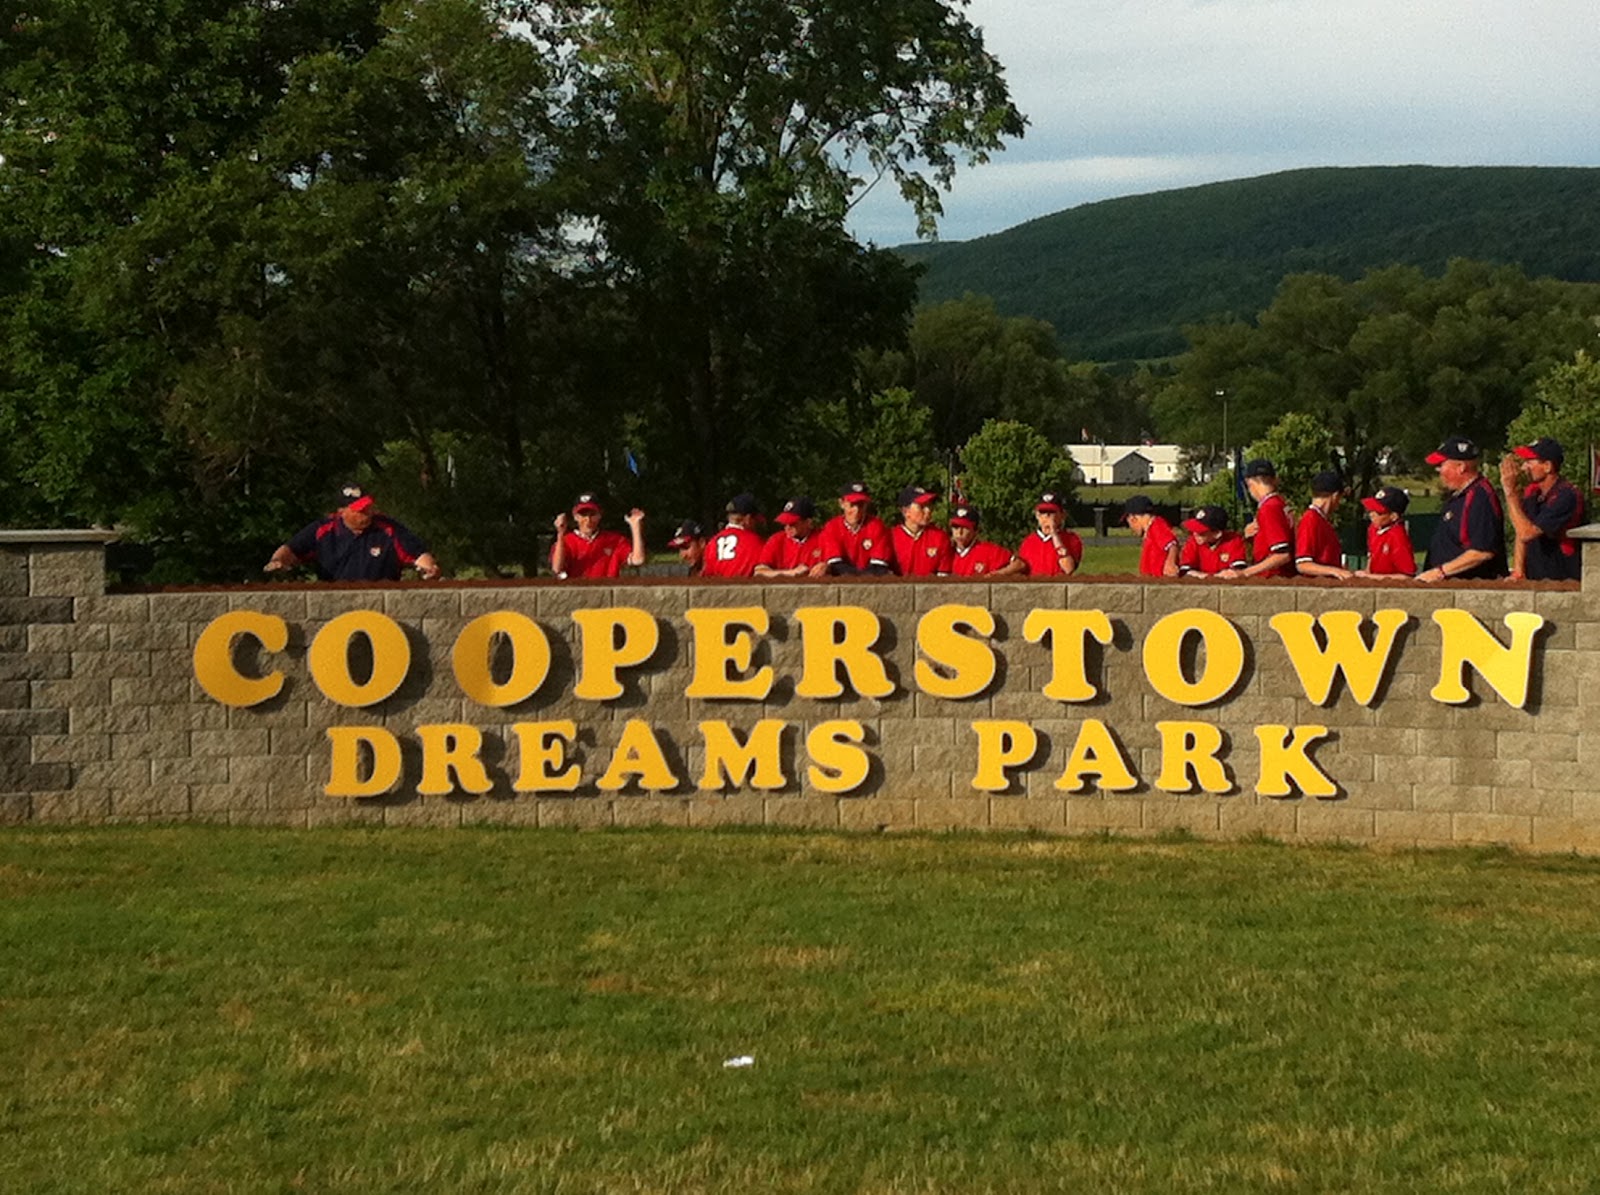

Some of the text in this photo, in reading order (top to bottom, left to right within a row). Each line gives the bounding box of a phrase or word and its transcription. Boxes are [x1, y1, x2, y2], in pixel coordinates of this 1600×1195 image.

[716, 535, 738, 561] 12
[193, 604, 1544, 710] COOPERSTOWN
[324, 718, 1338, 798] DREAMS PARK
